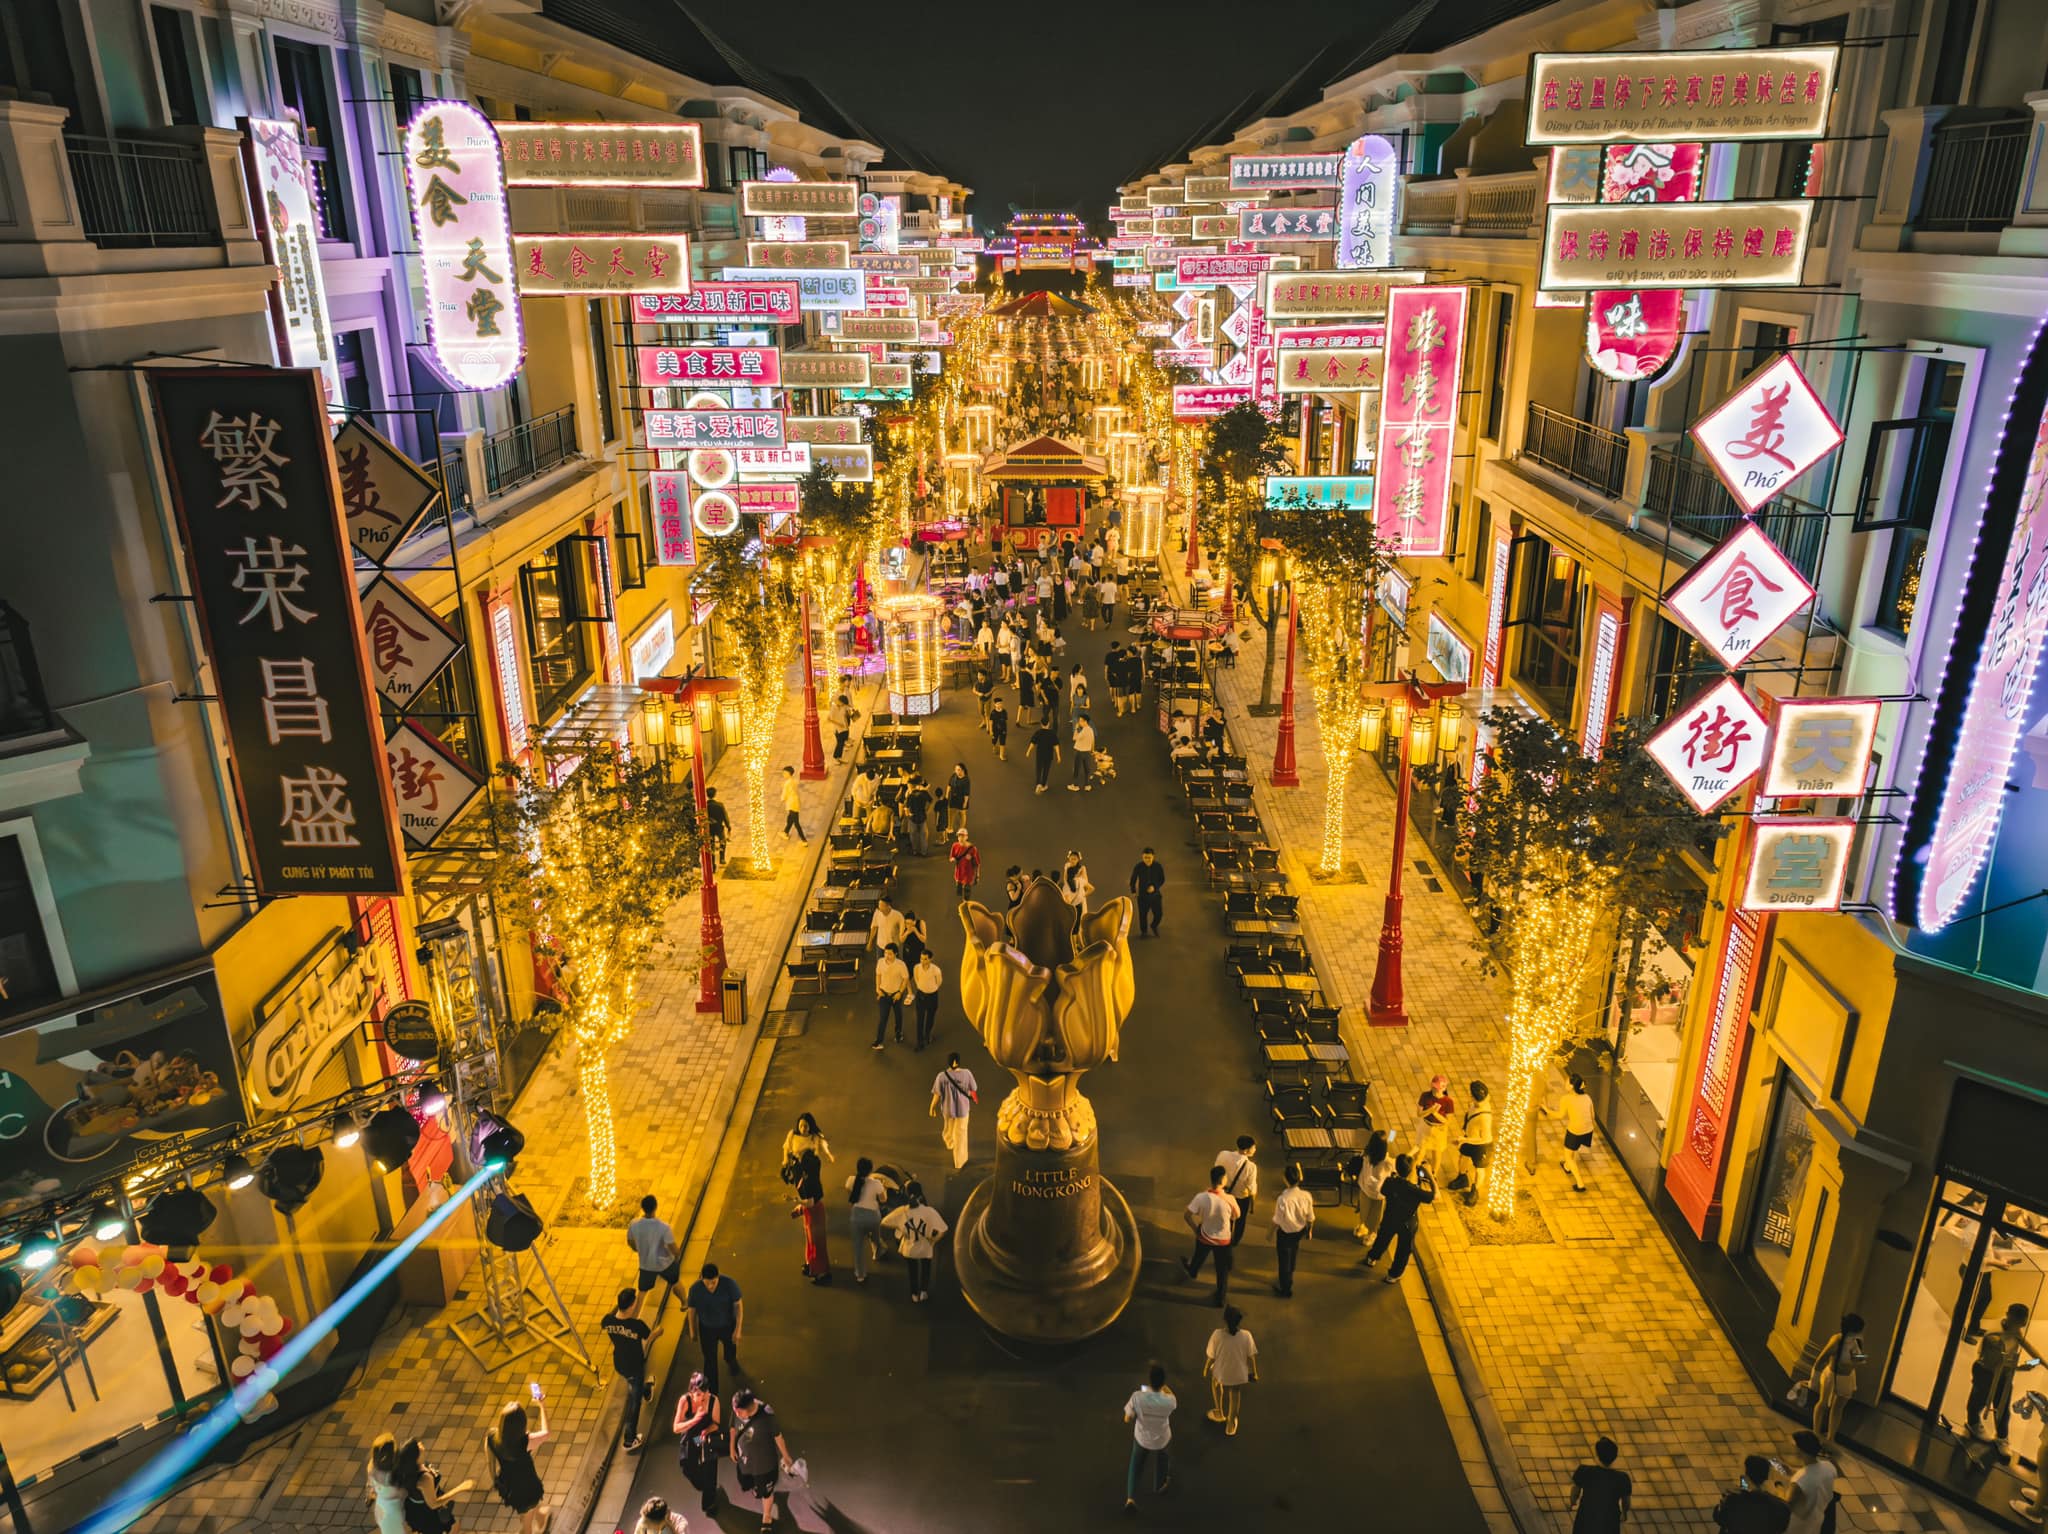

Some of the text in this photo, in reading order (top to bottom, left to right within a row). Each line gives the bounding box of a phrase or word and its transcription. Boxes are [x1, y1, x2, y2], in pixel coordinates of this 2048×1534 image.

[526, 245, 672, 281] 美食天堂
[657, 351, 764, 376] 美食天堂
[650, 414, 779, 438] 生活、爱和吃
[1725, 380, 1796, 472] 美
[1744, 469, 1785, 489] Phố
[704, 502, 728, 525] 堂
[358, 523, 392, 544] Phố
[1700, 551, 1785, 630] 食
[201, 409, 361, 848] 繁荣昌盛
[365, 599, 430, 675] 食
[1721, 628, 1752, 652] Ẩm
[385, 673, 413, 695] Ẩm
[1682, 705, 1753, 774] 街
[1790, 718, 1856, 774] 天
[1691, 775, 1729, 794] Thực
[1796, 779, 1834, 791] Thiên
[402, 812, 440, 829] Thực
[281, 866, 310, 879] CUNG
[1767, 834, 1832, 889] 堂
[1768, 892, 1815, 906] Đường
[248, 938, 384, 1109] Carlsberg
[1025, 1167, 1079, 1182] LITTLE
